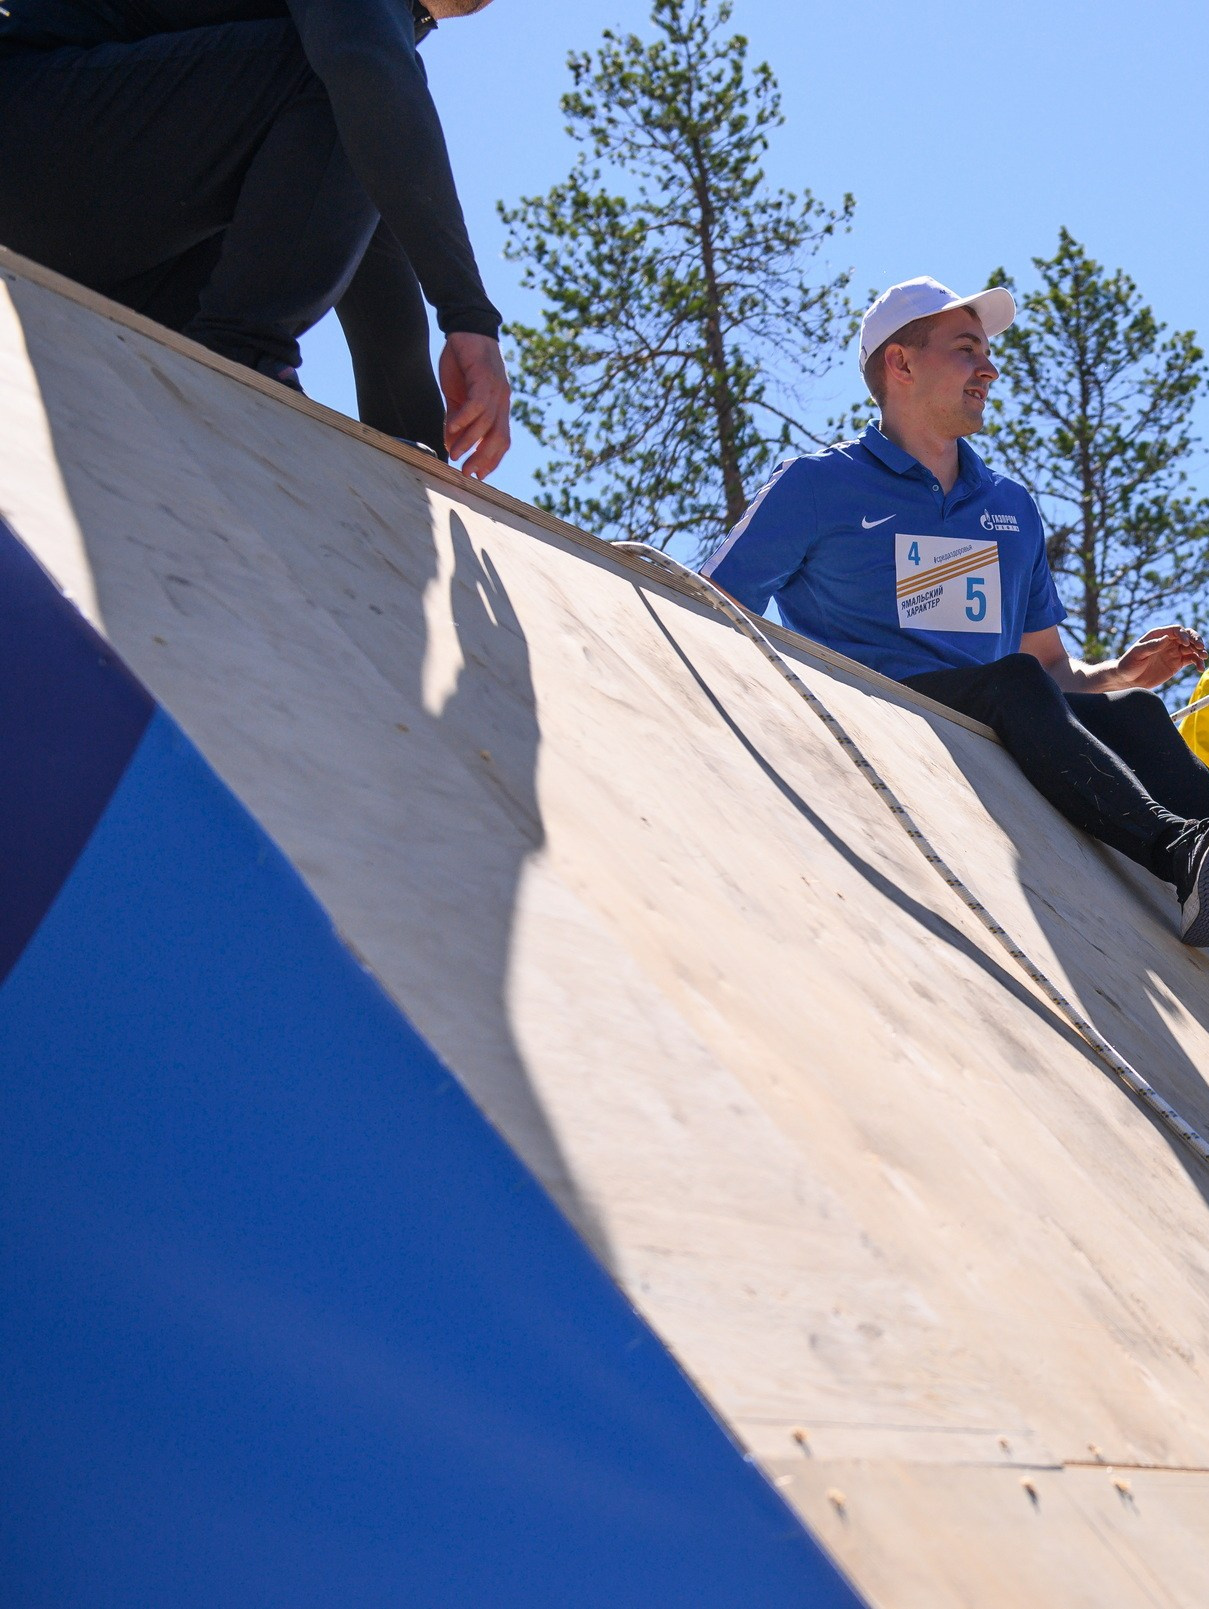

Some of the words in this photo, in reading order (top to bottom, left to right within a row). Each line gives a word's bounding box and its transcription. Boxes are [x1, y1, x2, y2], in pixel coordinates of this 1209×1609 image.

[991, 514, 1018, 525] ГАЗПРОМ
[907, 541, 921, 566] 4
[901, 585, 944, 610] ЯМАЛЬСКИЙ
[906, 597, 941, 618] ХАРАКТЕР
[965, 577, 987, 622] 5
